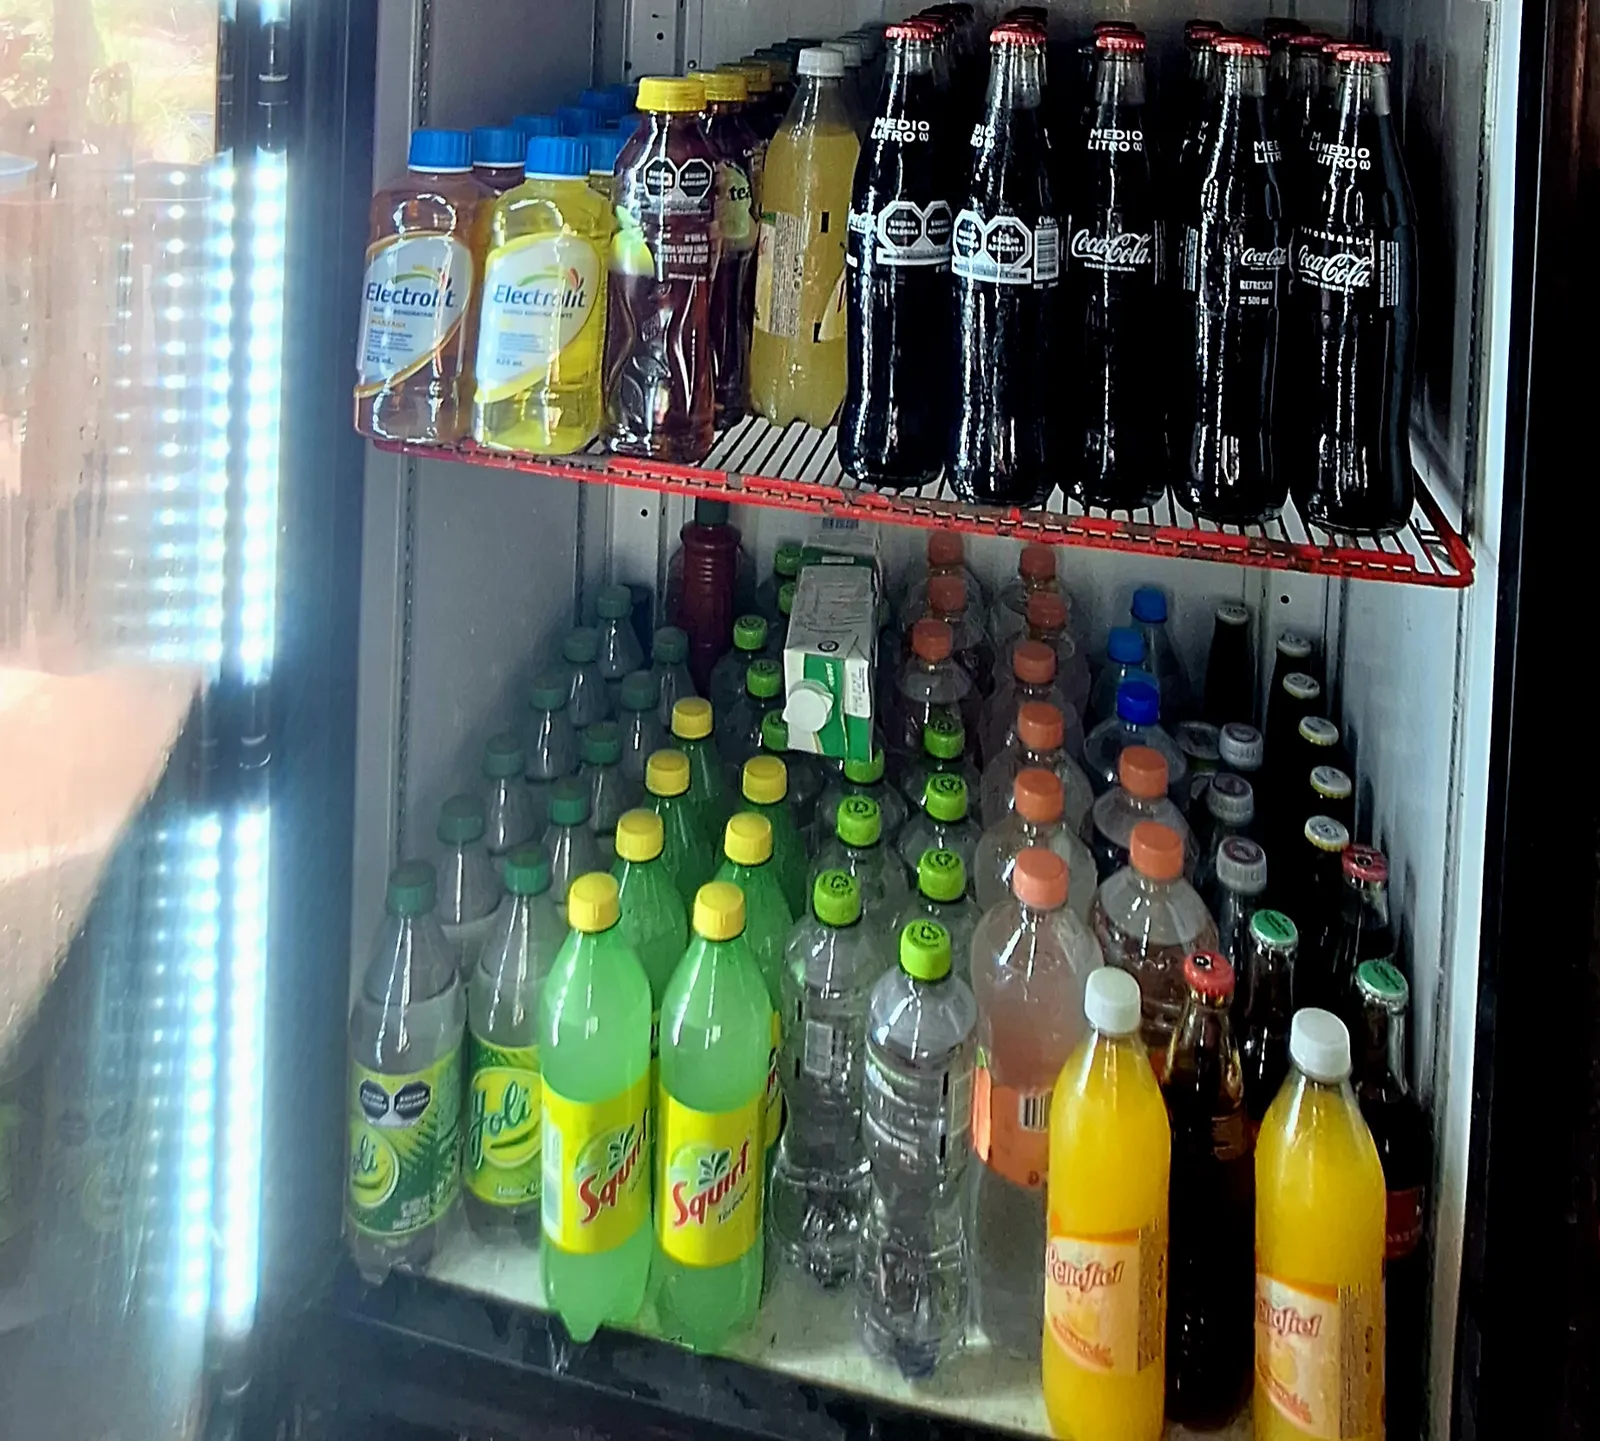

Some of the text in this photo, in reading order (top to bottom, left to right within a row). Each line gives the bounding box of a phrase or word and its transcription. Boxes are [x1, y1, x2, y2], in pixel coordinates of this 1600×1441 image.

[873, 116, 930, 132] MEDIO
[870, 127, 916, 143] LITRO
[1089, 128, 1144, 141] MEDIO
[1087, 139, 1131, 152] LITRO
[1322, 143, 1371, 159] MEDIO
[1071, 228, 1152, 264] Coca-Cola
[1240, 247, 1288, 266] Coca-Cola
[1298, 244, 1371, 288] Coca-Cola
[1239, 279, 1273, 290] REFRESCO
[365, 281, 456, 308] Electrolt
[672, 1136, 750, 1228] Squirt
